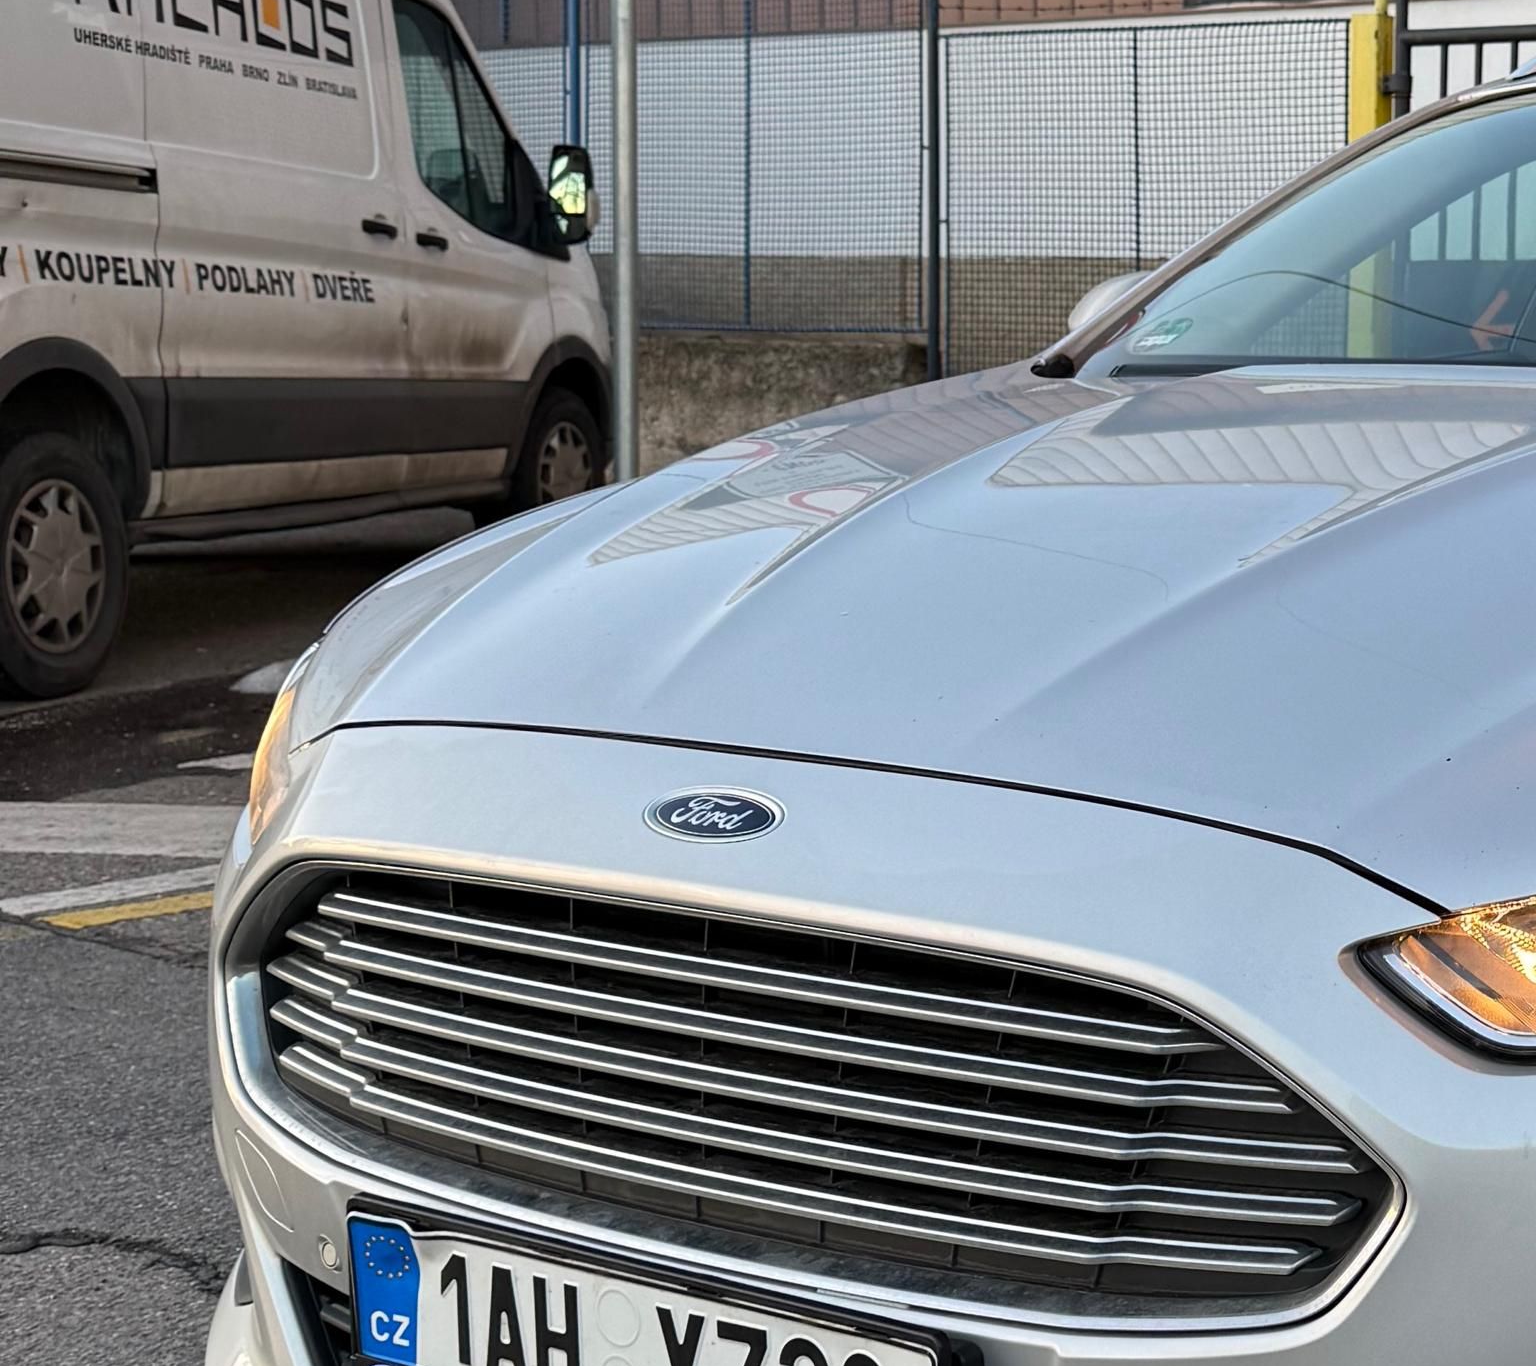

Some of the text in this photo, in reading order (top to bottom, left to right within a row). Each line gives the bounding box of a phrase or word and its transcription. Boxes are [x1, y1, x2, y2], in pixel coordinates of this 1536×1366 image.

[73, 27, 133, 53] UHERSKÉ
[198, 54, 234, 74] PRAHA
[242, 64, 269, 83] BRNO
[277, 70, 299, 88] ZLÍN
[35, 249, 175, 288] KOUPELNY
[195, 262, 296, 297] PODLAHY
[312, 270, 375, 303] DVEŘE
[671, 796, 754, 830] Ford
[370, 1310, 411, 1347] CZ
